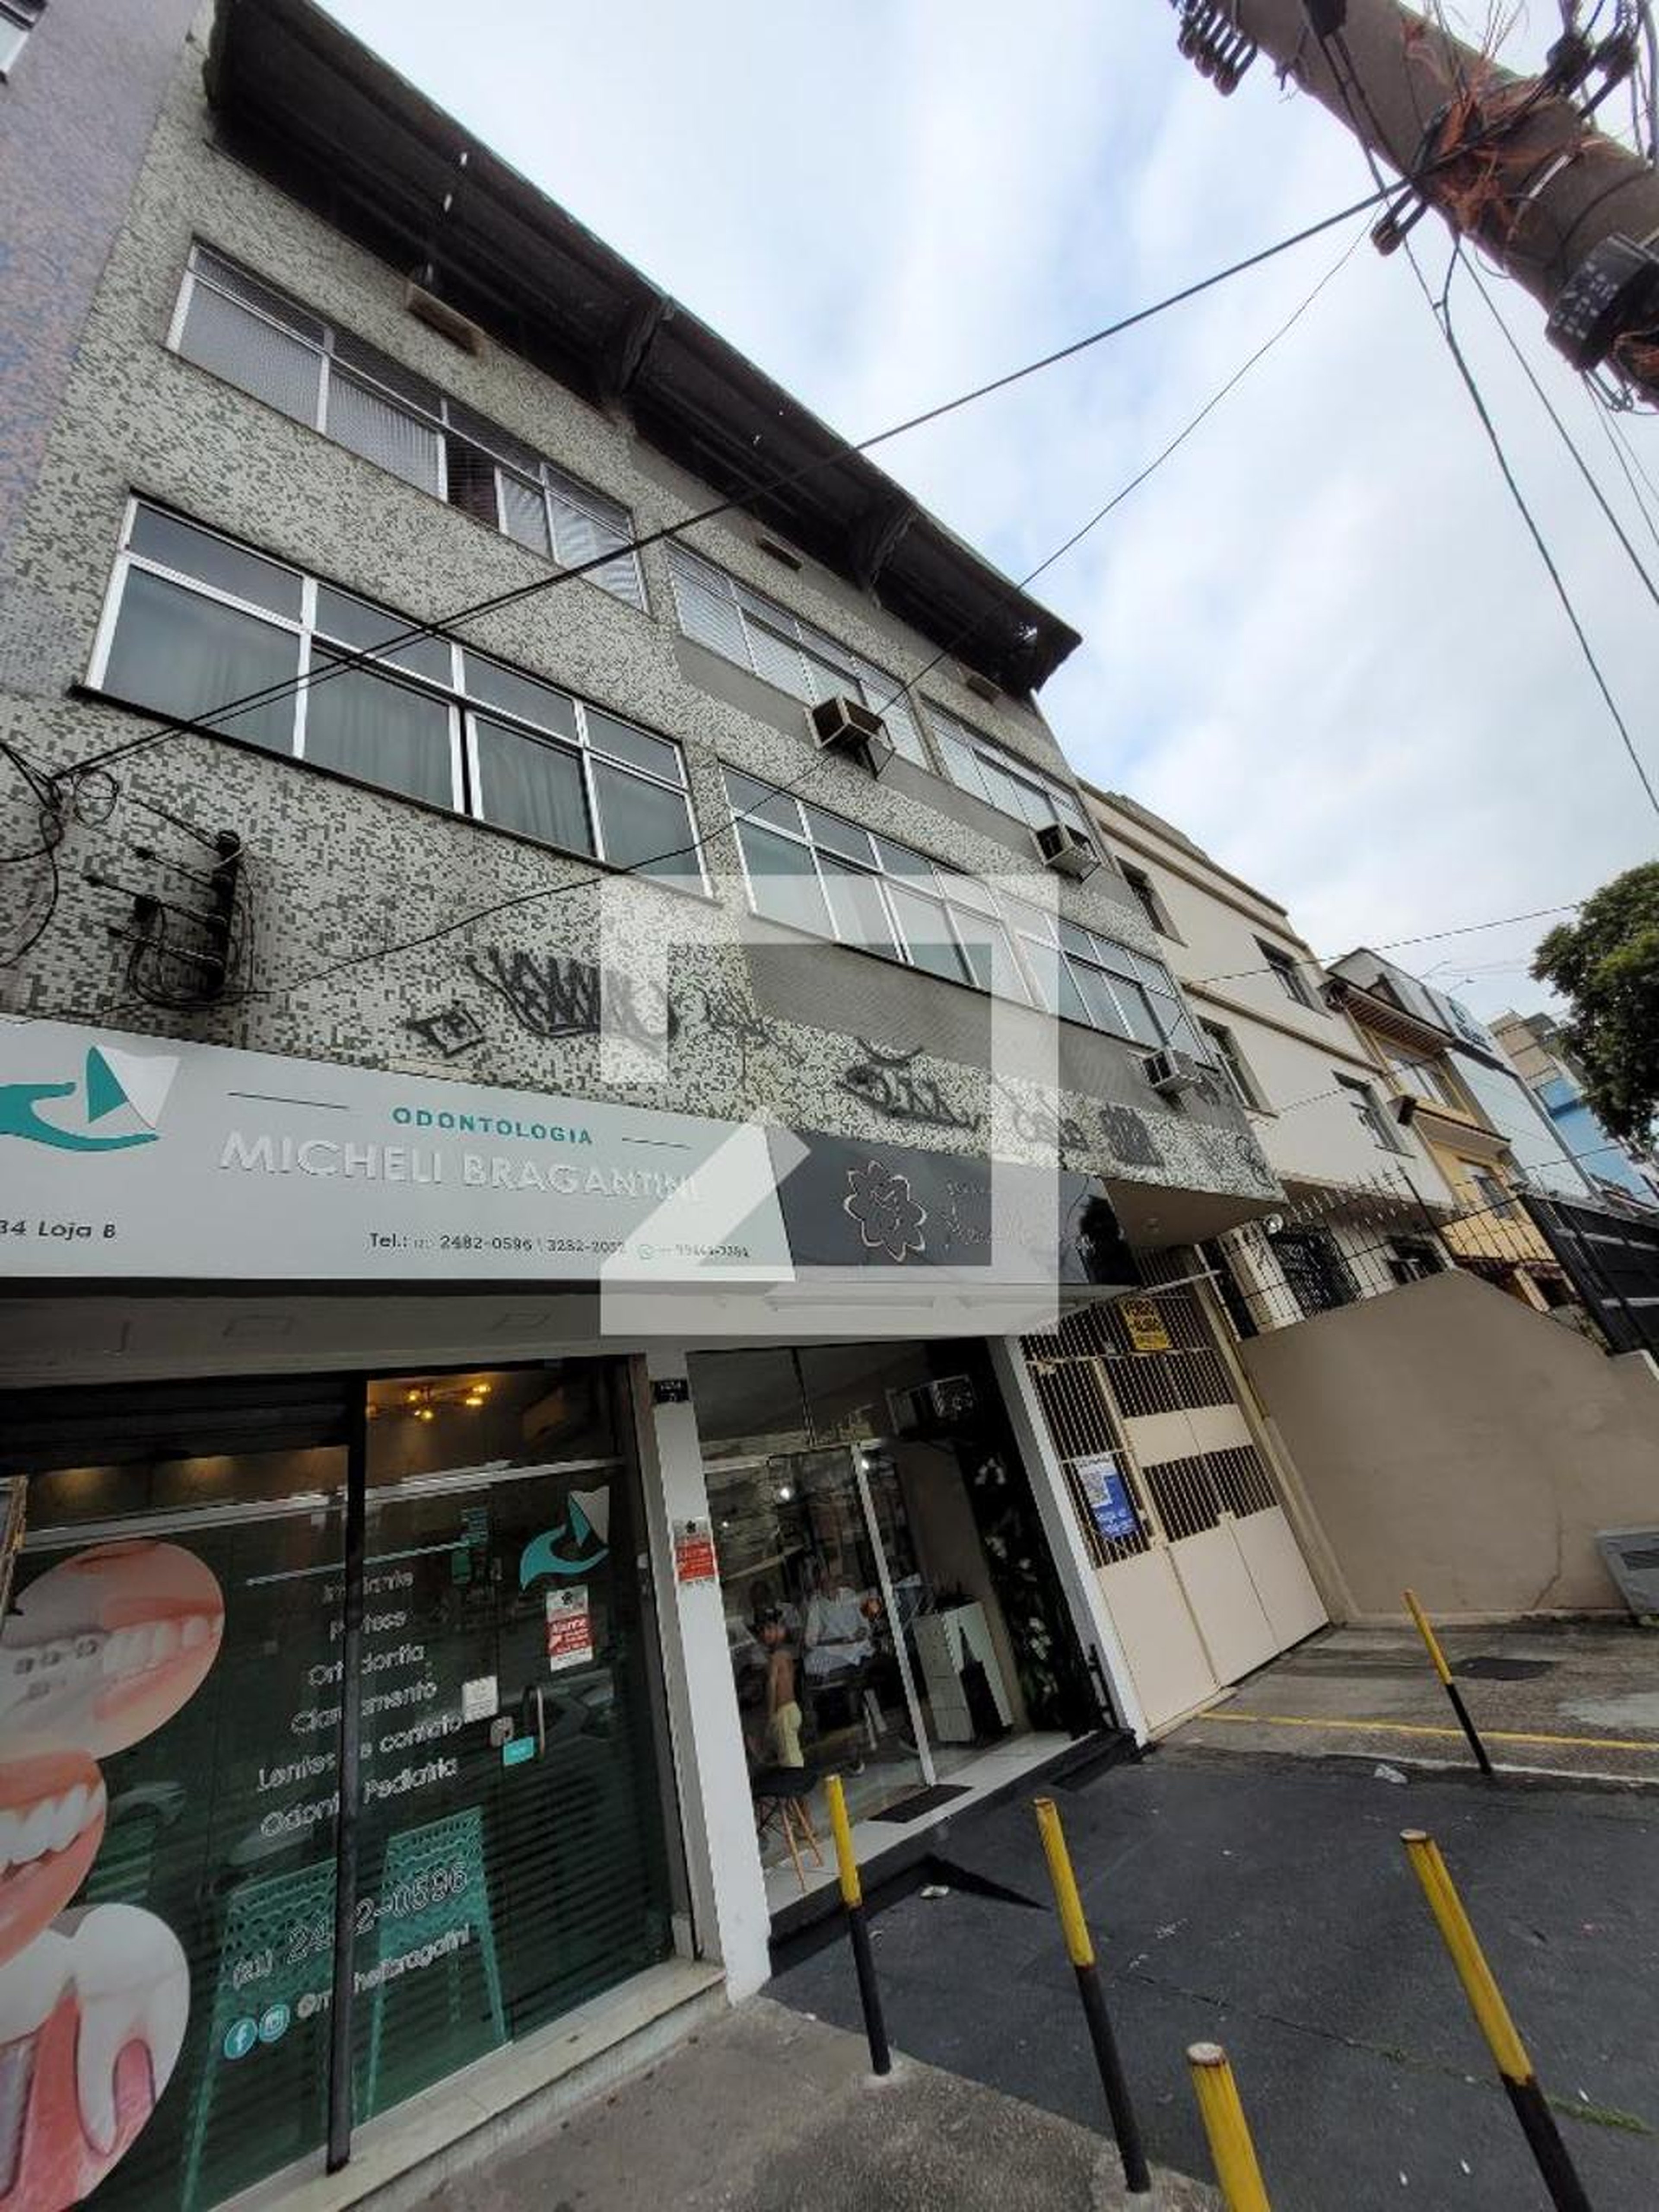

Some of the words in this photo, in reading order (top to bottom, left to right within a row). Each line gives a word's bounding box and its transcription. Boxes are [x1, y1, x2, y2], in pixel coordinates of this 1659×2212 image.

[392, 1108, 592, 1144] ODONTOLOGIA
[219, 1131, 442, 1184] MICHELI
[39, 1222, 91, 1240] Loja
[104, 1224, 115, 1238] B
[370, 1233, 407, 1248] Tel.:
[309, 1643, 424, 1685] Ortdontia
[286, 1860, 468, 1964] 242-0596
